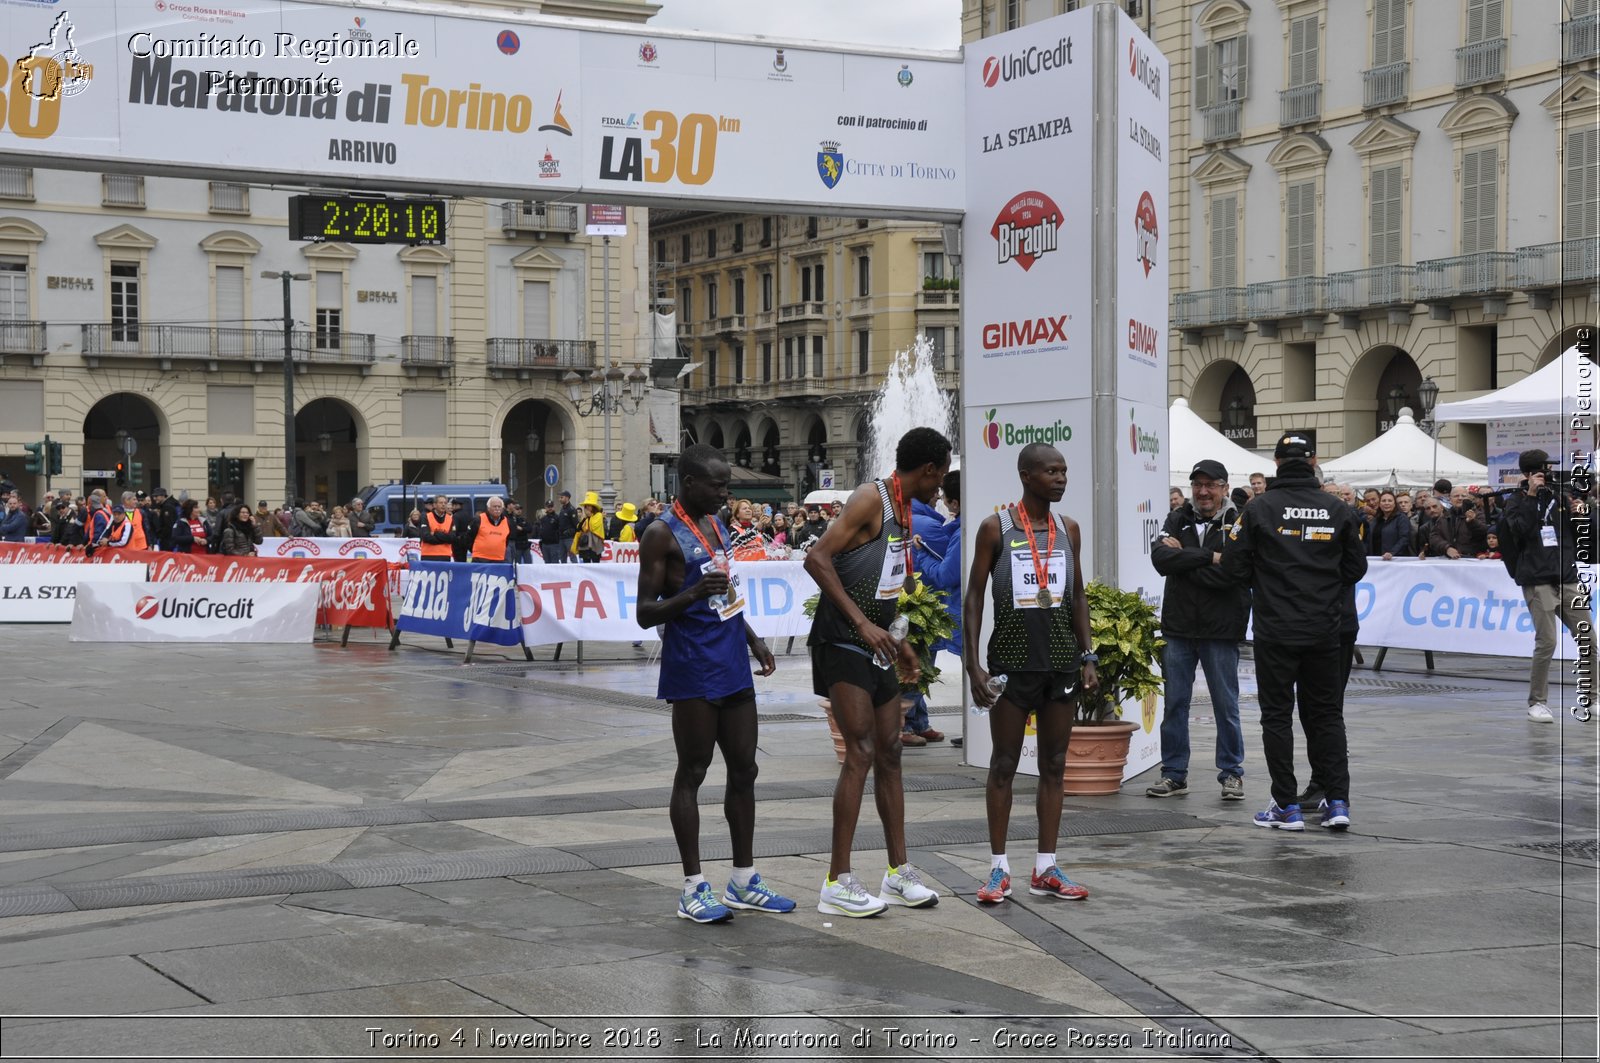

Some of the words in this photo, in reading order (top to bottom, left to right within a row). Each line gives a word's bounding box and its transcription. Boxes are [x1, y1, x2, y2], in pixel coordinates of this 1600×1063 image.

[169, 3, 192, 12] Croce
[193, 6, 217, 15] Rossa
[218, 9, 246, 18] Italiana
[348, 28, 372, 38] Torino
[1002, 36, 1072, 82] UniCredit
[1136, 46, 1161, 101] UniCredit
[129, 54, 337, 120] Maratona
[346, 83, 392, 124] di
[401, 74, 532, 133] Torino
[602, 117, 625, 126] FIDAL
[719, 115, 740, 132] km
[837, 115, 855, 126] con
[857, 115, 864, 127] il
[866, 117, 916, 131] patrocinio
[917, 120, 928, 131] di
[983, 133, 1003, 153] LA
[1008, 116, 1072, 147] STAMPA
[1129, 117, 1139, 144] LA
[1140, 125, 1162, 162] STAMPA
[328, 139, 397, 164] ARRIVO
[324, 201, 437, 239] 2:20:10
[998, 213, 1057, 264] Biraghi
[983, 315, 1067, 349] GIMAX
[1128, 318, 1157, 358] GIMAX
[1005, 419, 1072, 446] Battaglio
[1224, 428, 1255, 439] BANCA
[277, 538, 320, 556] TAPPOROSSO
[339, 538, 382, 556] TAPPOROSSO
[2, 586, 33, 599] LA
[162, 597, 254, 619] UniCredit
